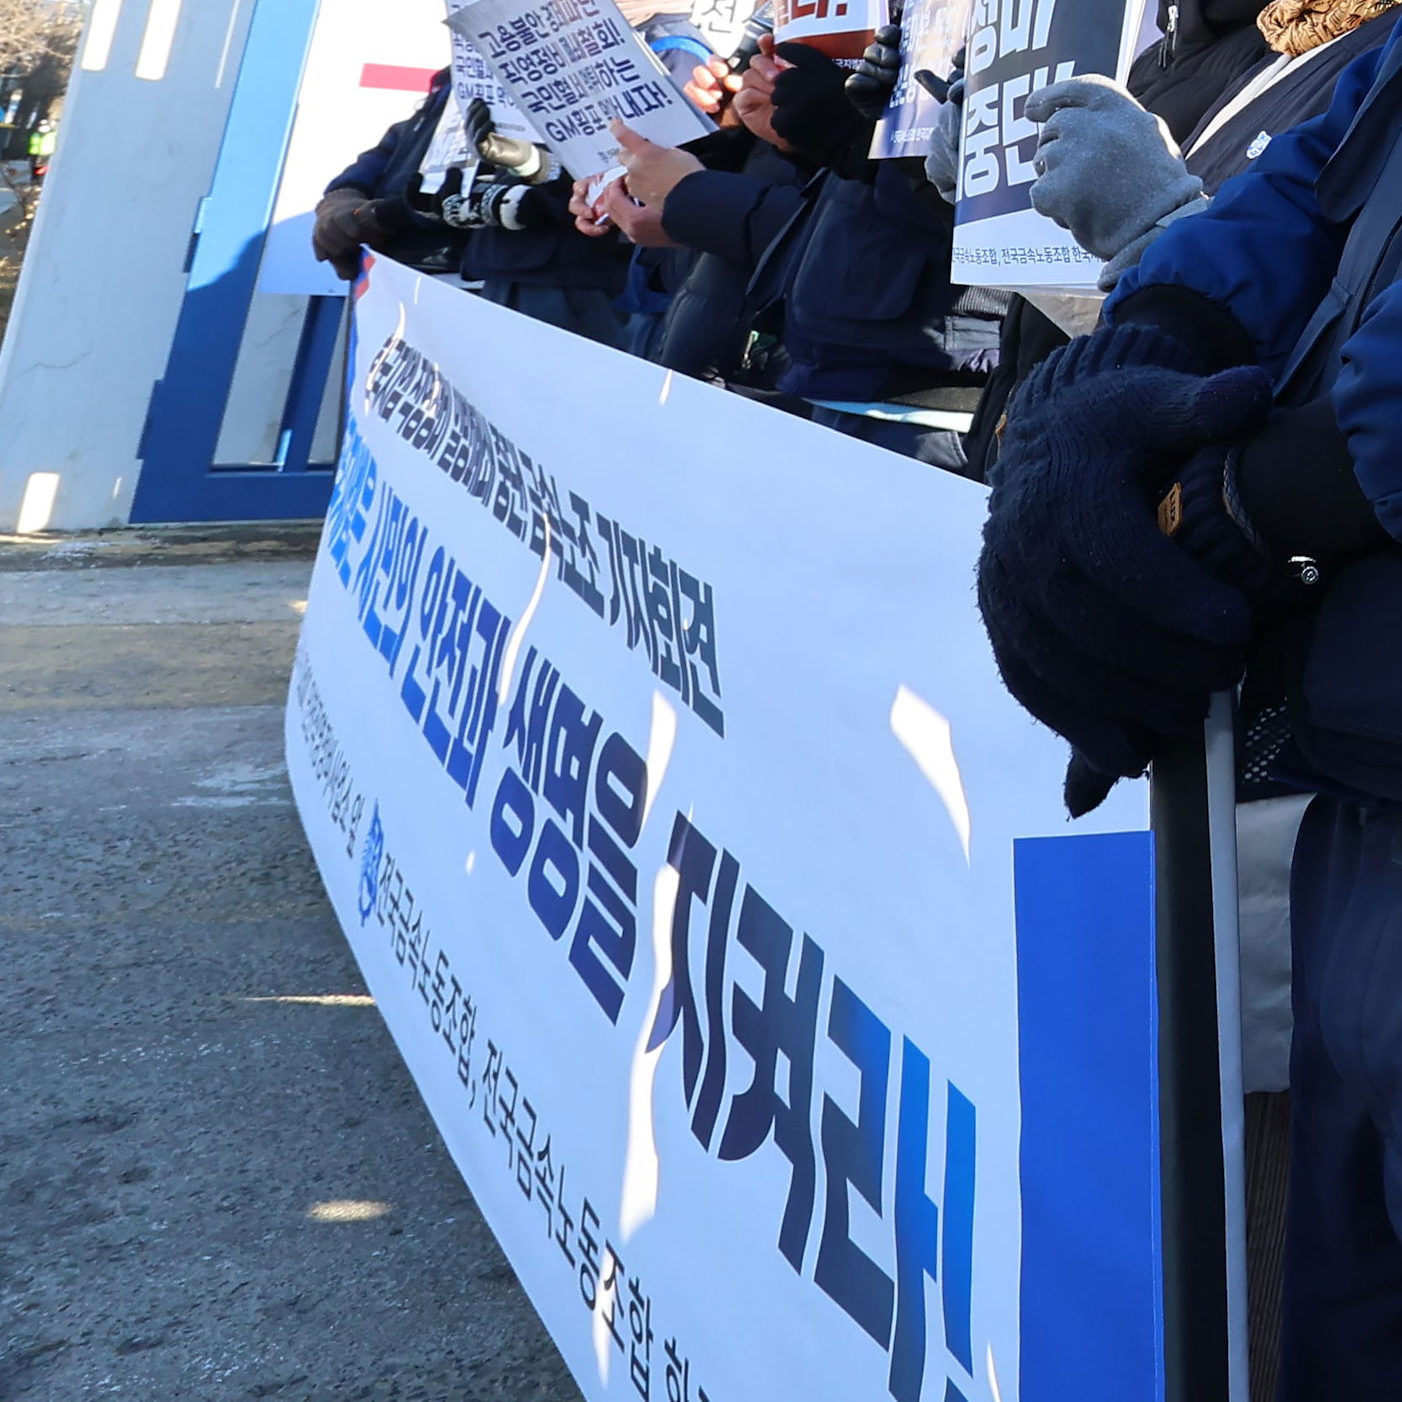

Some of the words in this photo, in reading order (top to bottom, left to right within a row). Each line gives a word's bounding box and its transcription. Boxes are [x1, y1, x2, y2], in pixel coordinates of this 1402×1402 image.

[478, 10, 550, 59] 고용불안
[499, 40, 570, 85] 직영정비
[545, 104, 607, 142] GM횡포
[1001, 247, 1070, 264] 전국금속노동조합
[596, 512, 725, 739] 기자회견
[400, 546, 512, 810] 안전과
[490, 645, 648, 1026] 생명을
[375, 850, 479, 1111] 전국금속노동조합,
[482, 1038, 655, 1402] 전국금속노동조합
